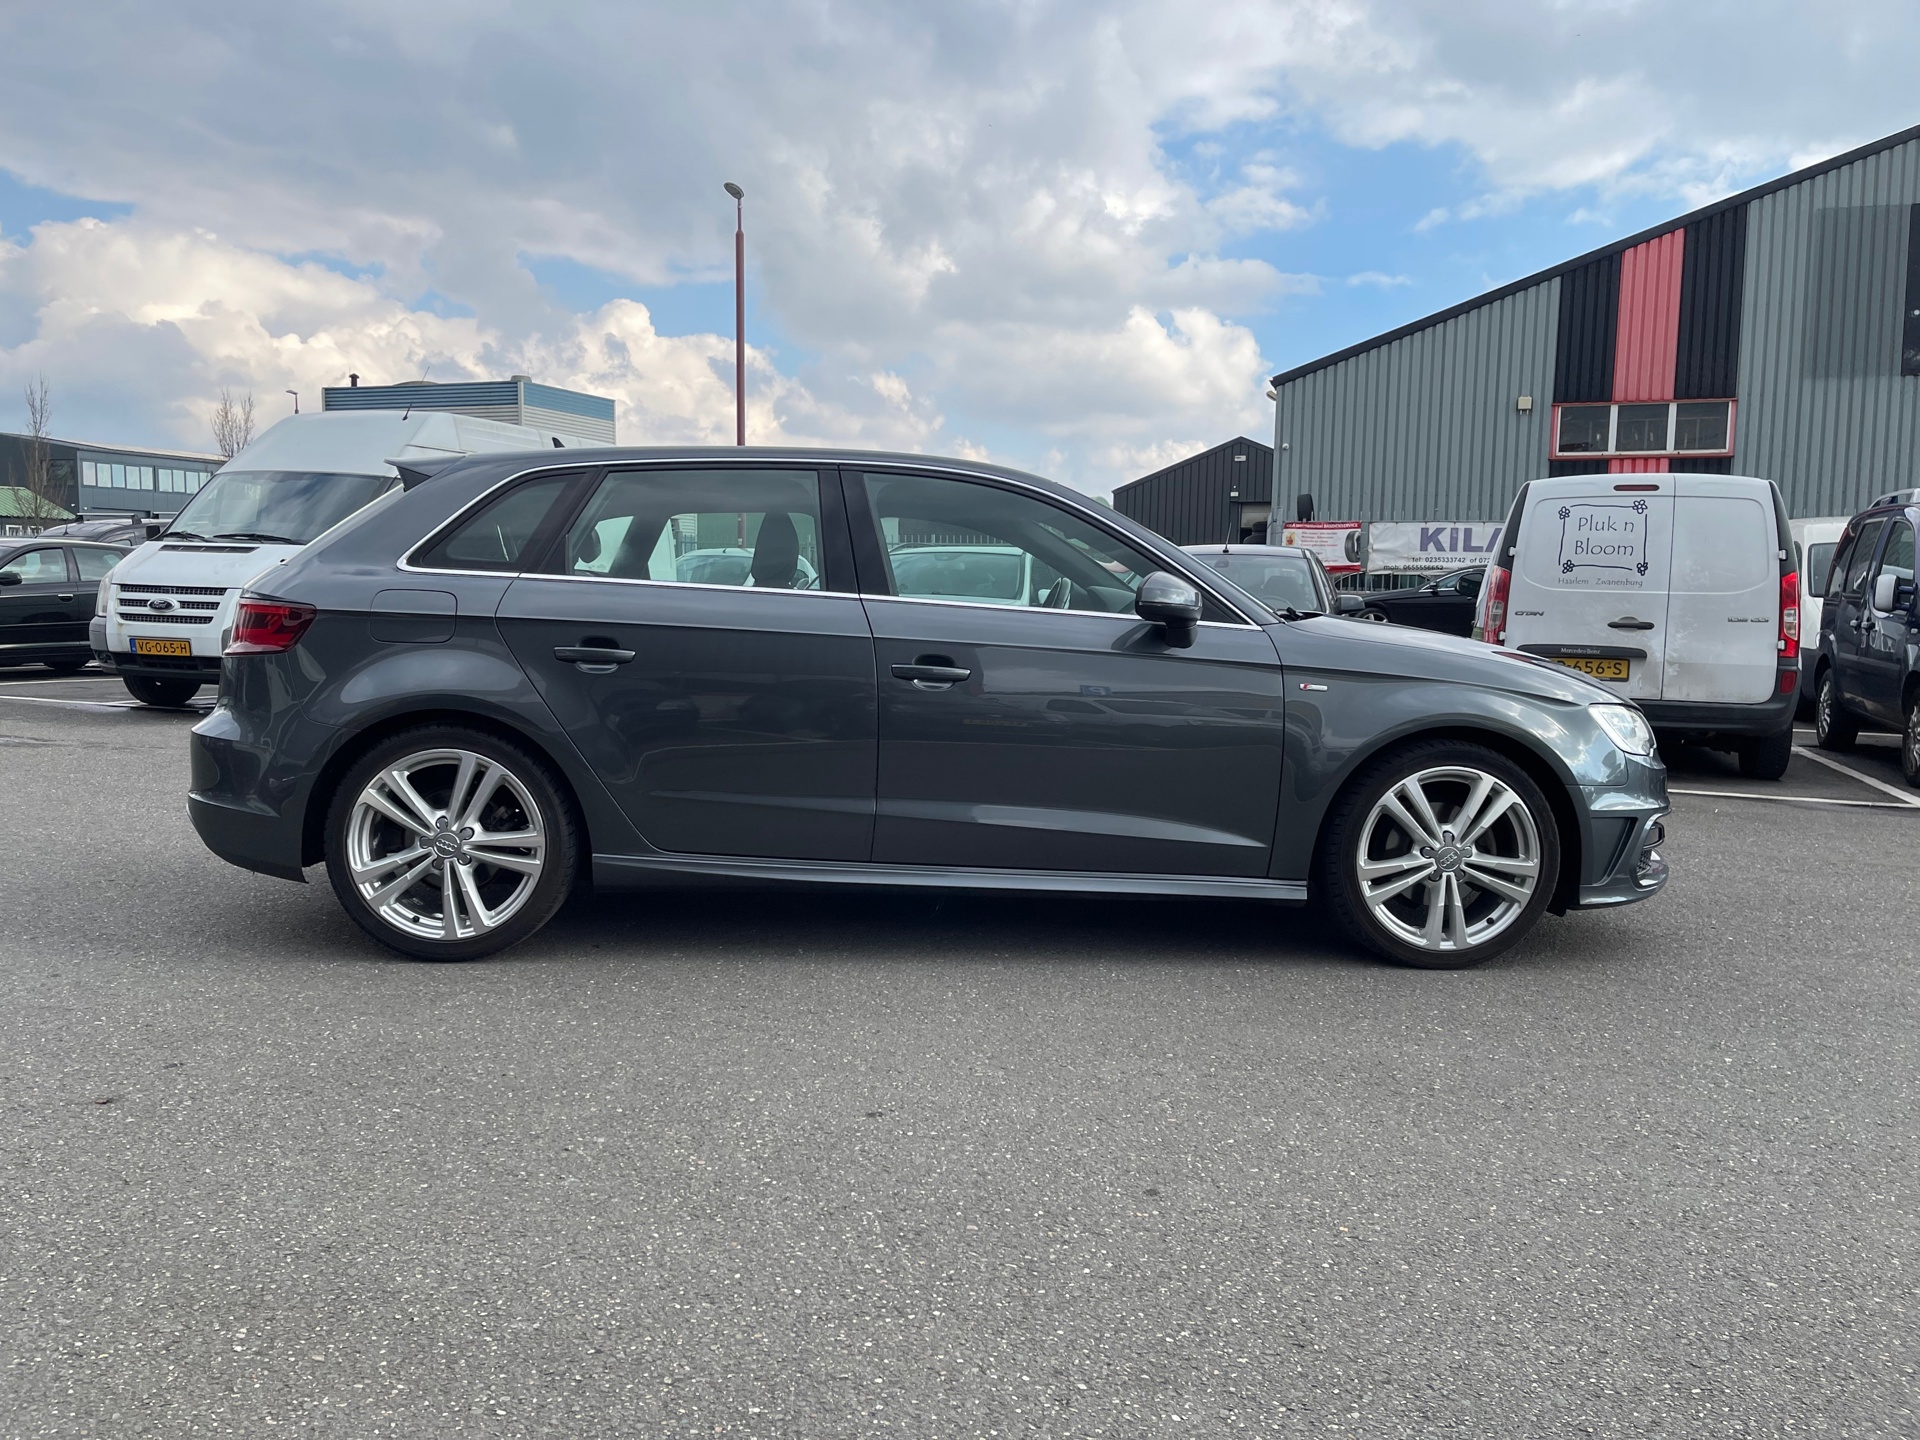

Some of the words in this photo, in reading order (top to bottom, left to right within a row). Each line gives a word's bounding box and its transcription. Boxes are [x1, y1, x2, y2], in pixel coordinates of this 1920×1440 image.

[1577, 514, 1617, 532] Pluk
[1624, 521, 1634, 532] n
[1574, 538, 1634, 556] Bloom
[1425, 556, 1466, 564] 0235333742
[1558, 577, 1589, 585] Haarlem
[1595, 578, 1643, 588] Zwanenburg
[137, 641, 187, 654] VG-065-H
[1560, 647, 1601, 655] Mercedes-Benz
